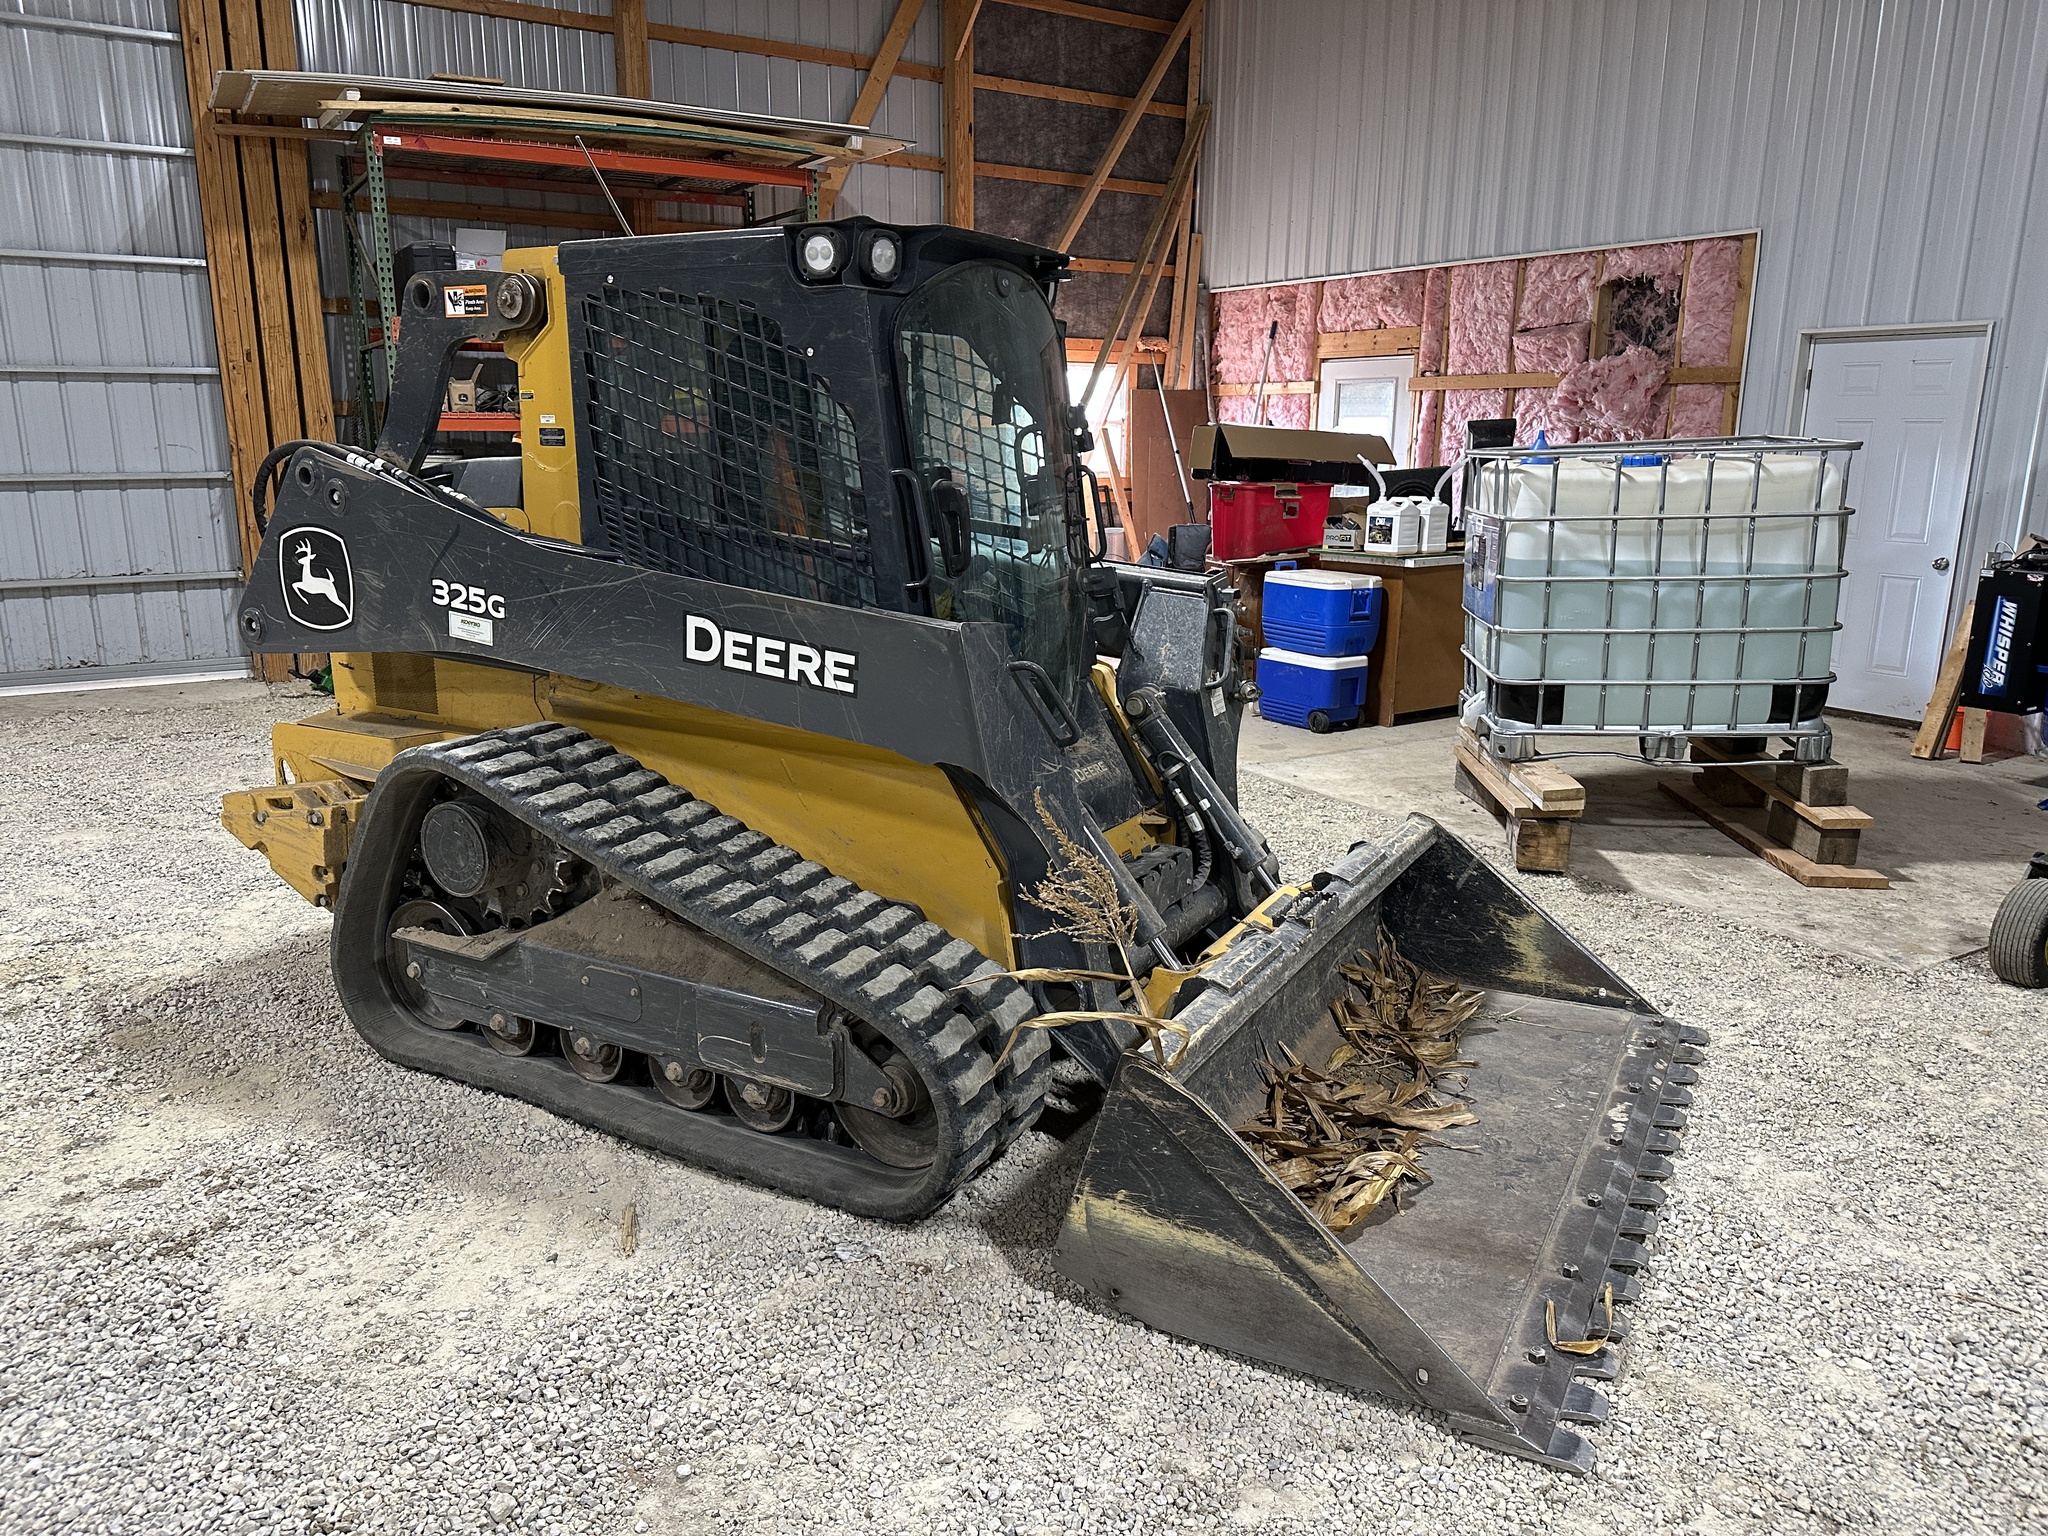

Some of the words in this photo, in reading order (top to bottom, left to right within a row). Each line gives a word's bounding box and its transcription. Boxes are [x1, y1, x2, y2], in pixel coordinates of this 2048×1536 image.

[432, 579, 506, 619] 325G
[686, 614, 856, 694] DEERE
[1993, 600, 2018, 687] WHISPER
[1073, 761, 1108, 782] DEERE
